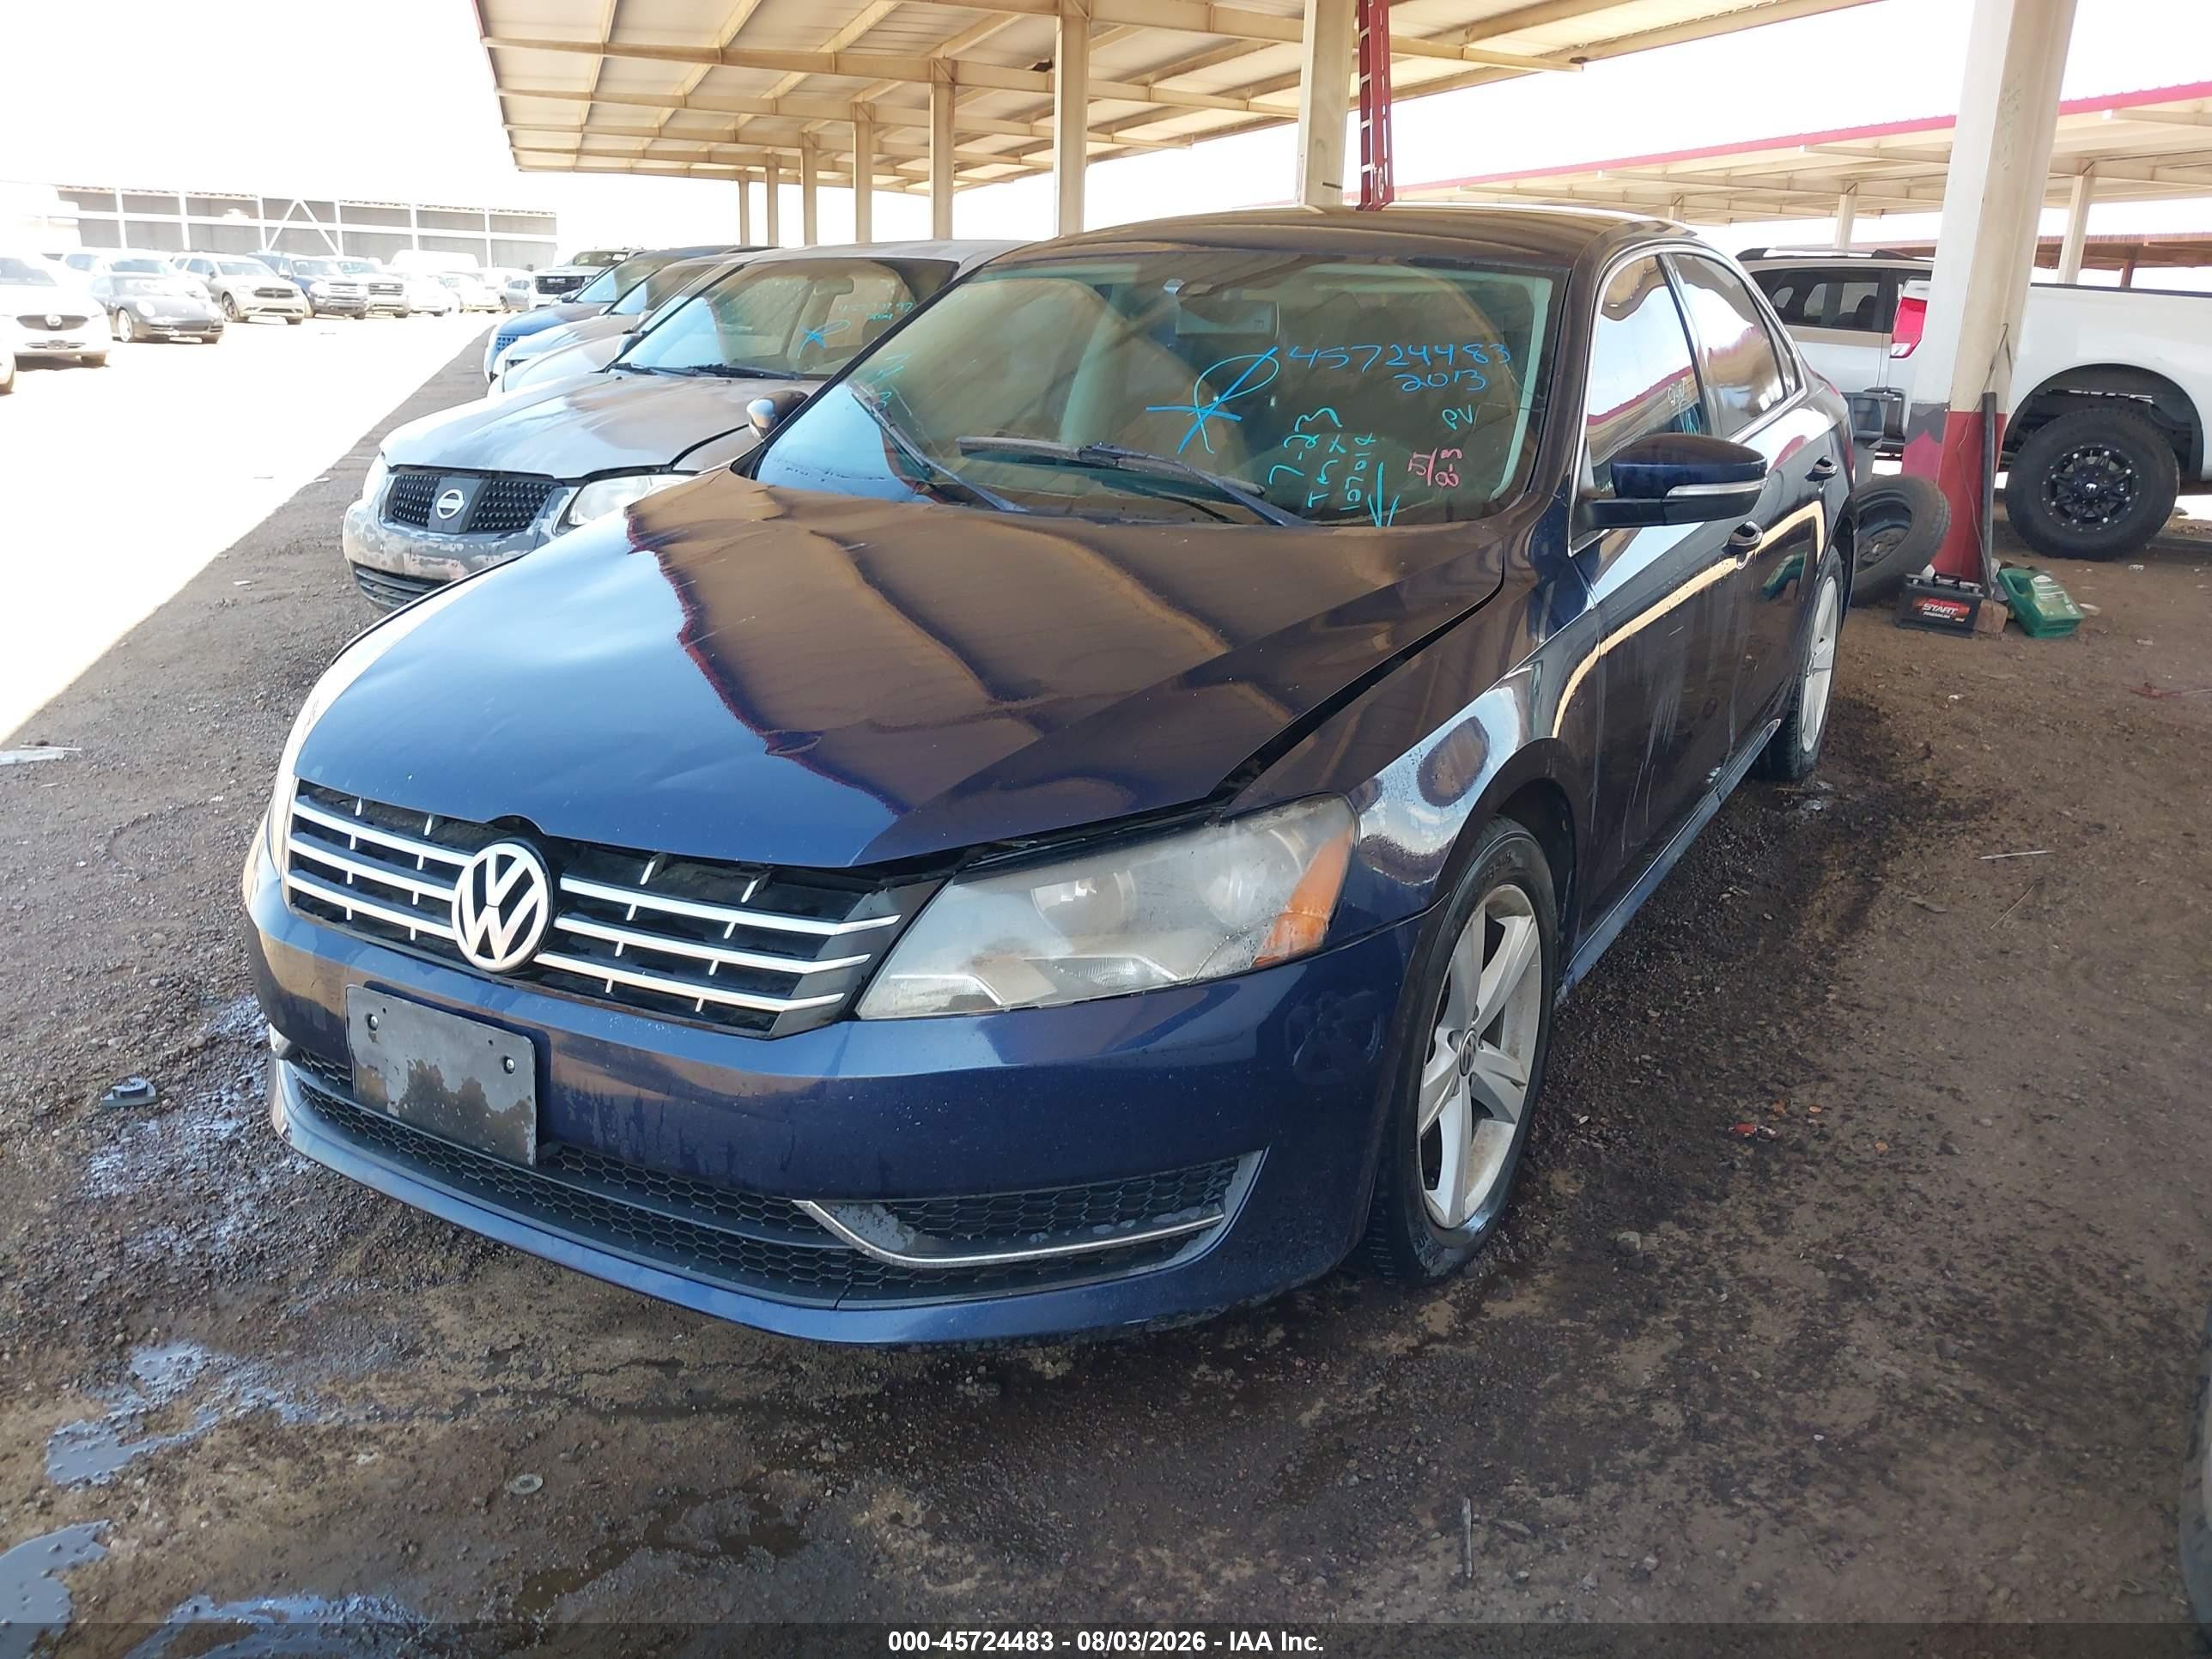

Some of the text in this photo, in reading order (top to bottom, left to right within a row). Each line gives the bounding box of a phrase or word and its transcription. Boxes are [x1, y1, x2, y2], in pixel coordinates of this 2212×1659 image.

[1289, 343, 1511, 373] 45724483
[1394, 369, 1487, 392] 2013
[1922, 603, 1959, 615] START
